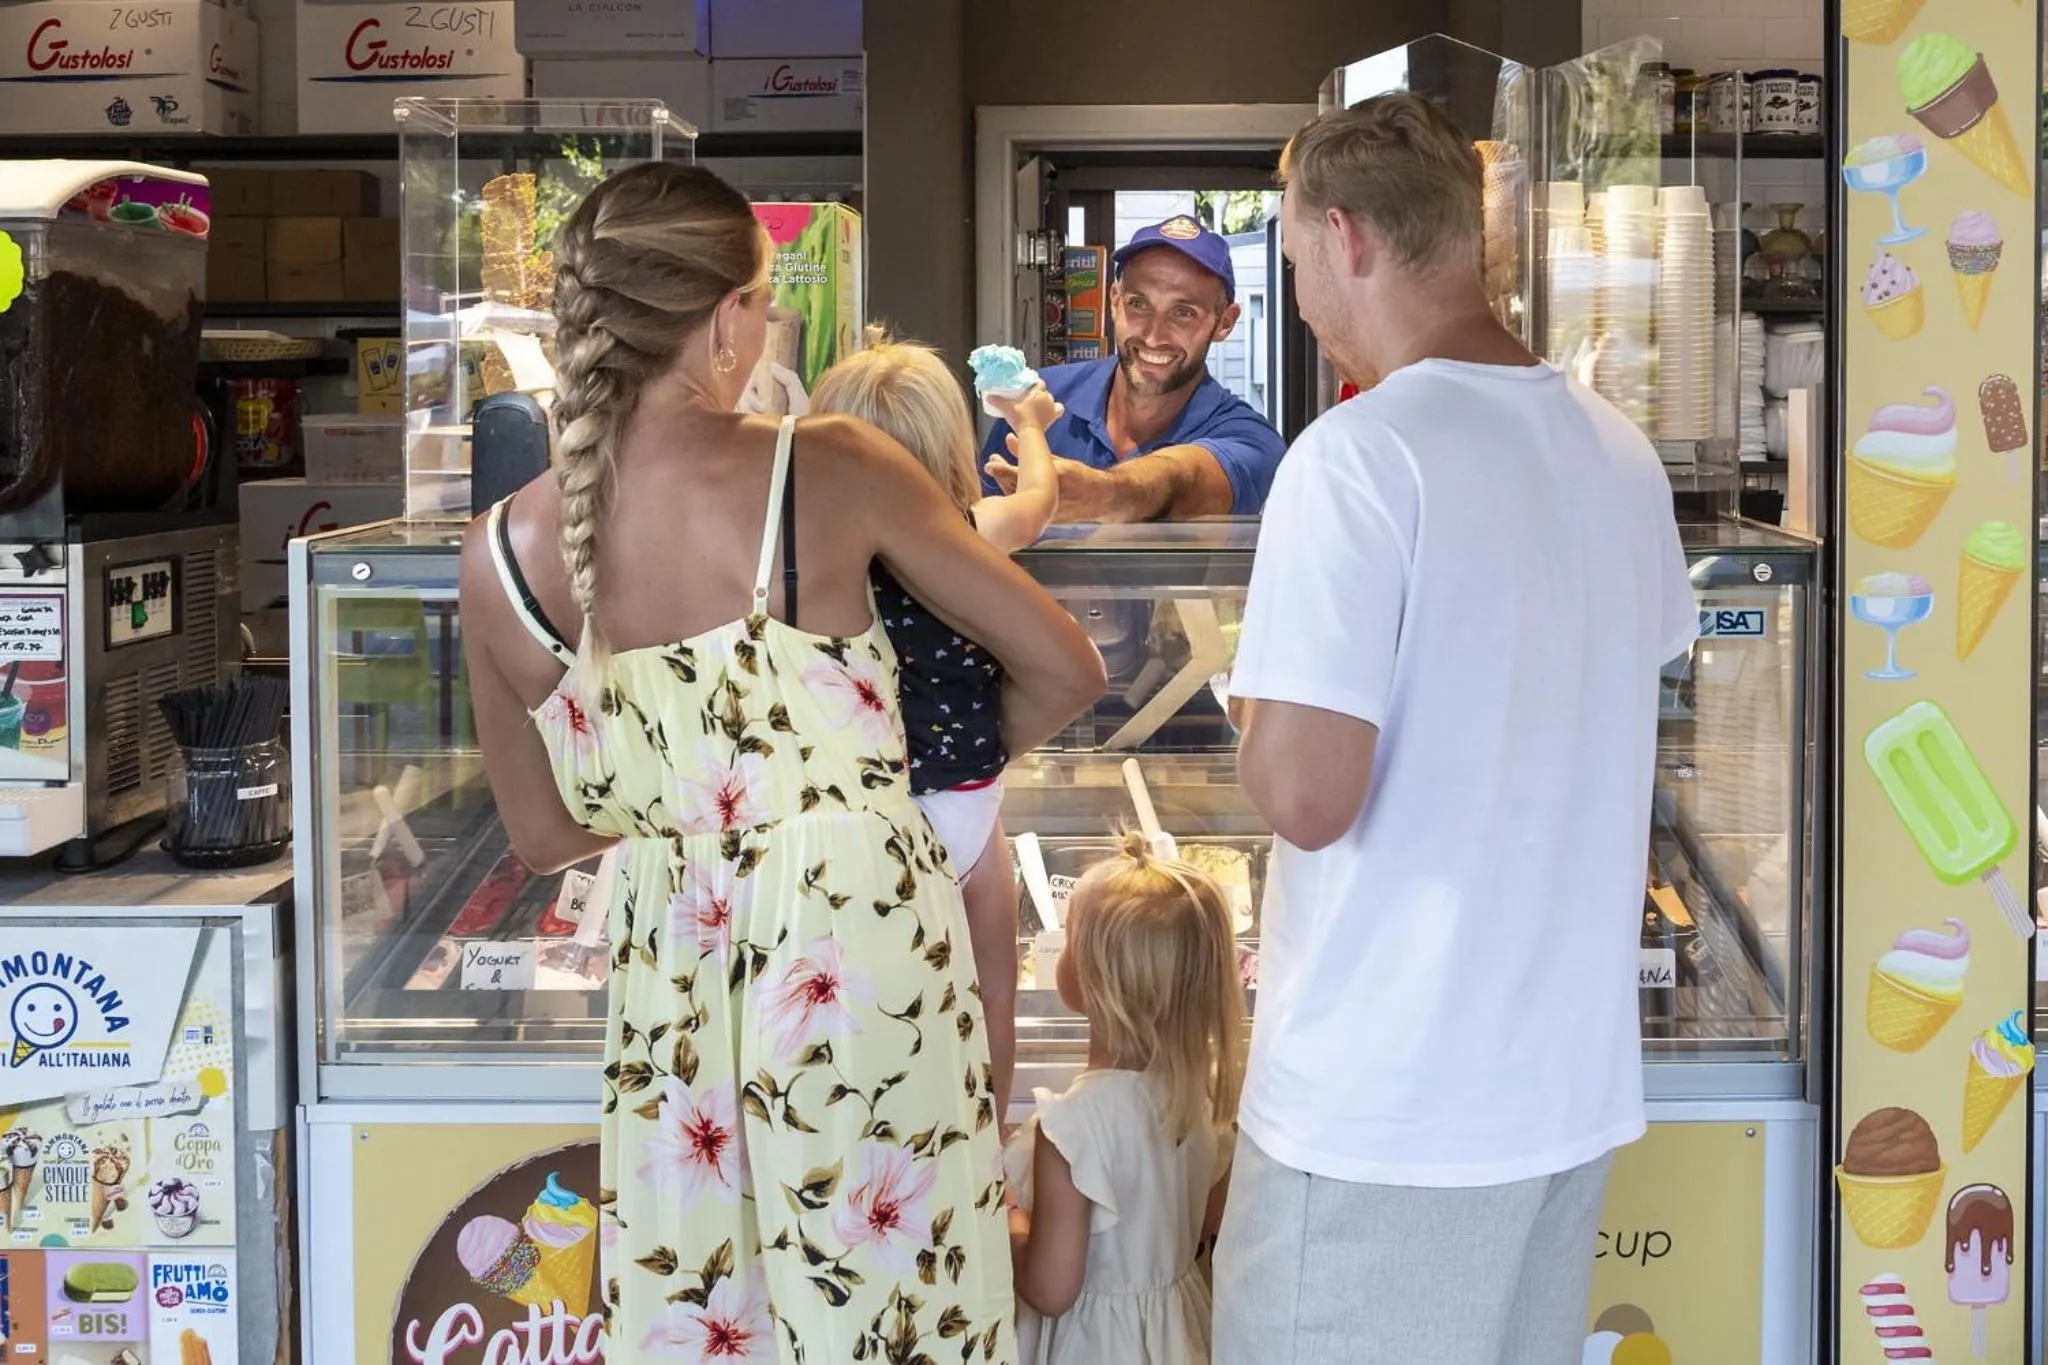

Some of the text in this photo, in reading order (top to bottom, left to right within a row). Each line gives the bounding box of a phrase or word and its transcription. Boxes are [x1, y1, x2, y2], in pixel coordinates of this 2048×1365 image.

[776, 251, 807, 262] egani
[1716, 611, 1749, 630] ISA
[466, 946, 521, 968] YOGURT
[0, 951, 130, 1033] MONTANA
[38, 1052, 132, 1067] ALL'ITALIANA
[174, 1132, 221, 1156] Coppa
[175, 1152, 214, 1170] d'Oro
[43, 1166, 89, 1185] CINQUE
[45, 1185, 88, 1202] STELLE
[153, 1264, 206, 1288] FRUTTI
[78, 1313, 128, 1334] BIS!
